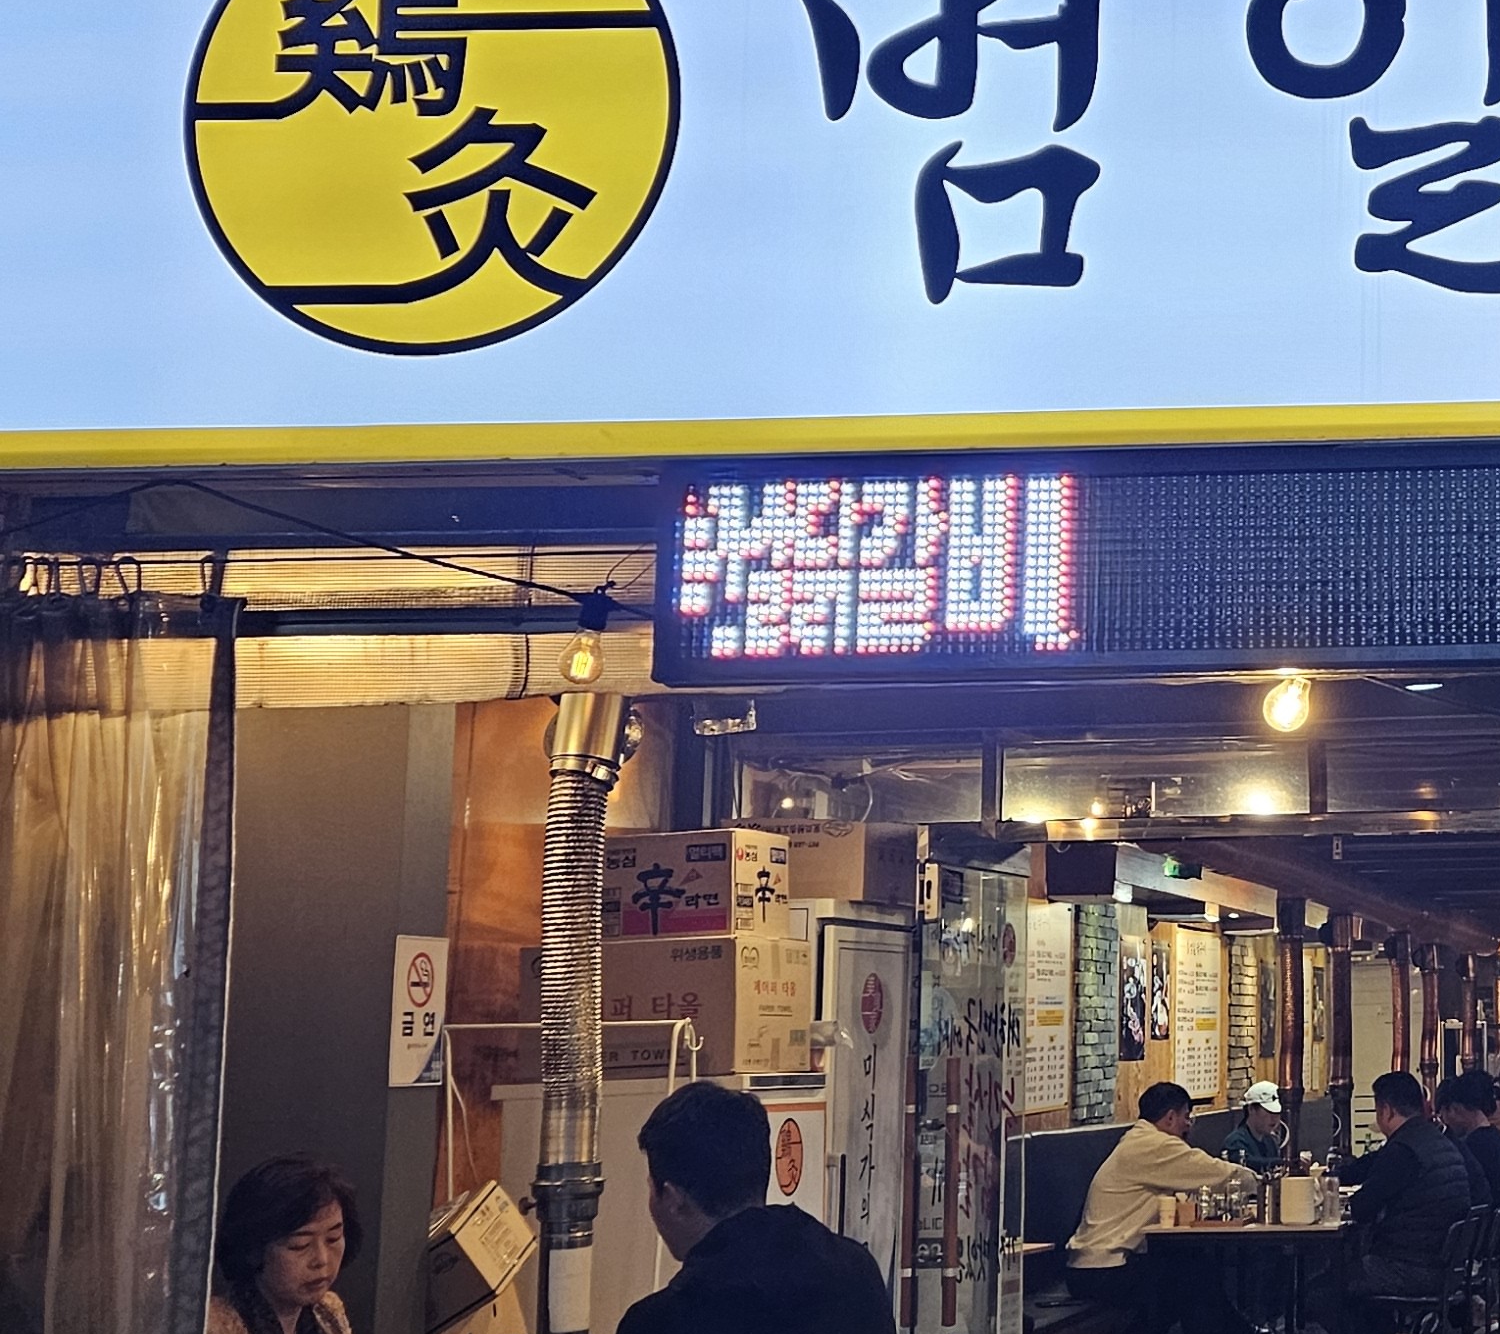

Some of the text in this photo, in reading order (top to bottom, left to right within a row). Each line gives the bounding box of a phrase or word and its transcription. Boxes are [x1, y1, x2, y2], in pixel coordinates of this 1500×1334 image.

[631, 862, 687, 936] 辛
[684, 893, 720, 908] 라면
[670, 946, 723, 961] 위생용품
[652, 992, 702, 1018] 타올
[402, 1011, 435, 1037] 금연
[859, 1043, 877, 1225] 미식가의
